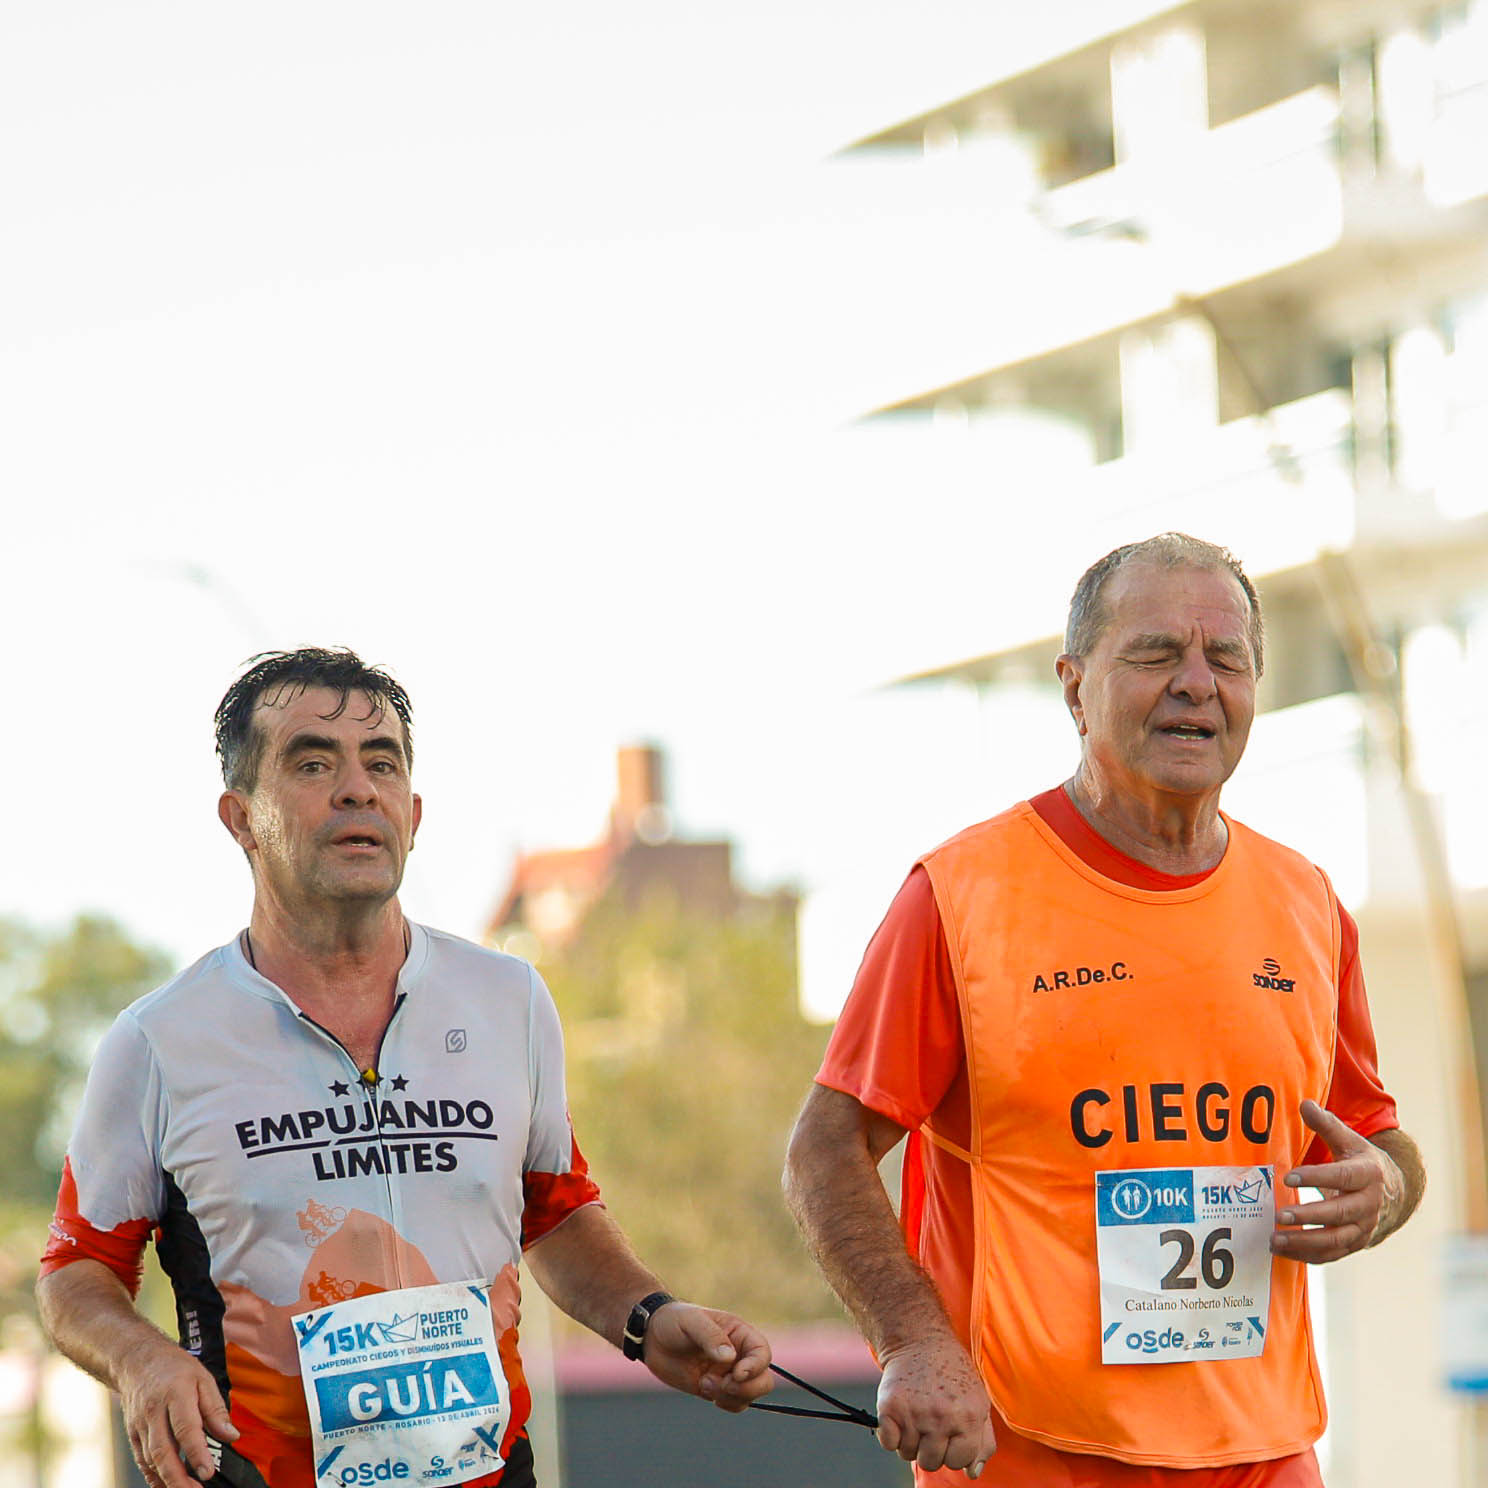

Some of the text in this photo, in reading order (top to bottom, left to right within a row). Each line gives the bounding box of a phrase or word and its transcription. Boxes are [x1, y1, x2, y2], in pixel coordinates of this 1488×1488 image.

[1032, 961, 1134, 993] A.R.De.C.
[235, 1099, 495, 1150] EMPUJANDO
[1070, 1082, 1275, 1149] CIEGO
[312, 1142, 458, 1181] LIMITES
[1151, 1186, 1189, 1208] 10K
[1201, 1185, 1233, 1205] 15K
[1159, 1227, 1235, 1290] 26
[420, 1308, 469, 1326] PUERTO
[1125, 1295, 1254, 1312] Catalano Norberto Nicolas
[323, 1322, 380, 1356] 15K
[421, 1322, 463, 1340] NORTE
[311, 1356, 368, 1372] CAMPEONATO
[369, 1350, 399, 1361] CIEGOS
[450, 1337, 484, 1349] VISUALES
[347, 1361, 476, 1421] GUÍA
[323, 1428, 356, 1440] PUERTO
[358, 1423, 386, 1433] NORTE
[395, 1417, 431, 1429] ROSARIO
